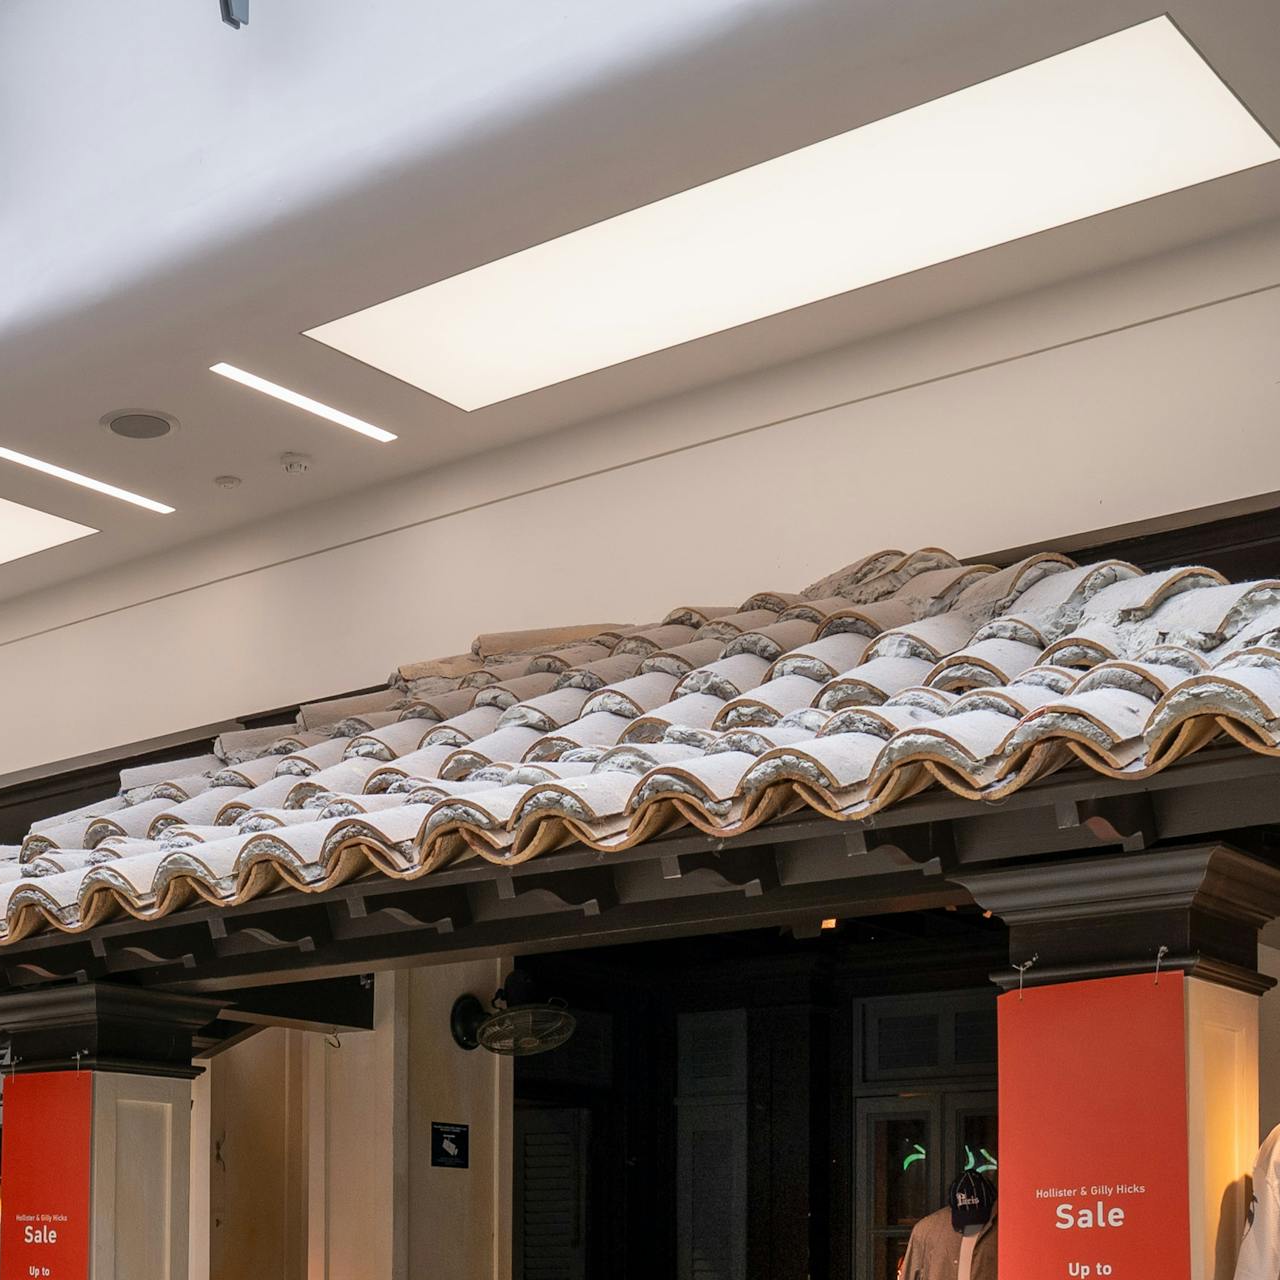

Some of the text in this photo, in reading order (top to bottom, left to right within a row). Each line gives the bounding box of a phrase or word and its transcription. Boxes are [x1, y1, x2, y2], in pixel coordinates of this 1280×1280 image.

[1036, 1184, 1146, 1199] Hollister & Gilly Hicks
[1055, 1201, 1124, 1229] Sale
[24, 1225, 57, 1244] Sale
[29, 1266, 50, 1278] Up to
[1068, 1262, 1112, 1279] Up to
